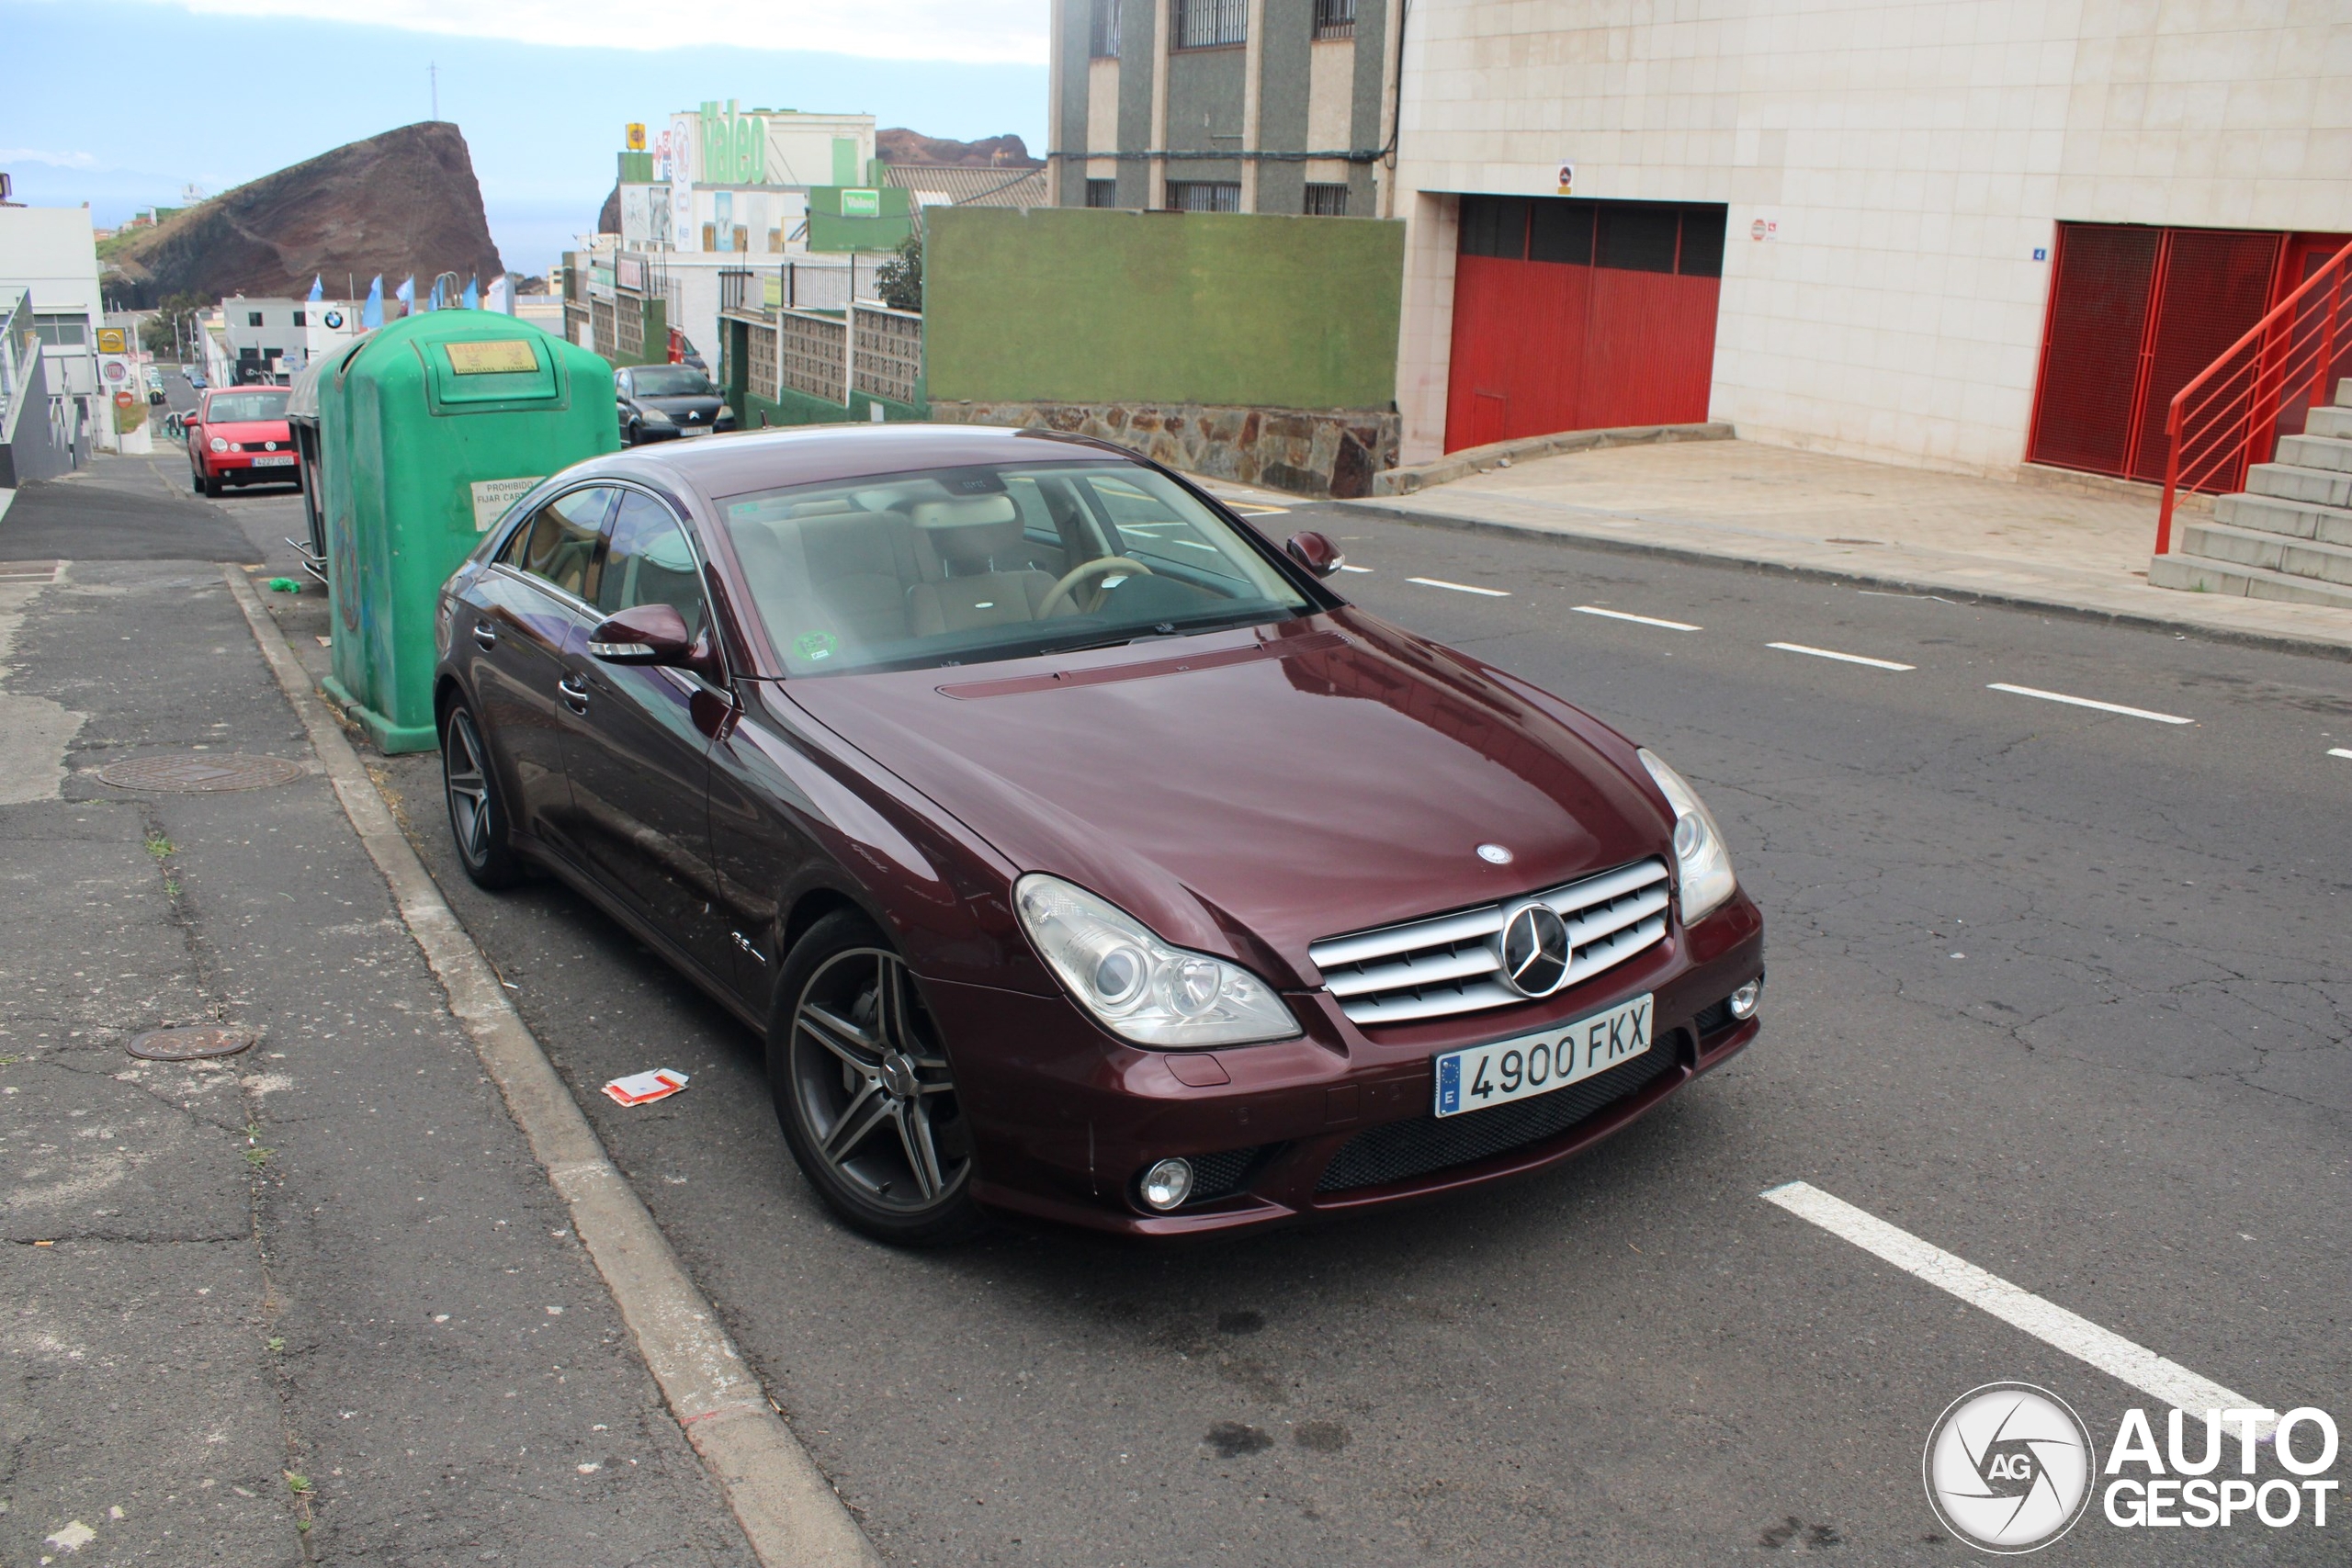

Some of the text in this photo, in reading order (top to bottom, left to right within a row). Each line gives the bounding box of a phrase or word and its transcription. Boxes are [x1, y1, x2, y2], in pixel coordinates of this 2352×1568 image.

[846, 196, 876, 209] Valeo
[487, 480, 533, 492] PROHIBIDO
[478, 493, 500, 503] FIJAR
[1470, 1004, 1646, 1100] 4900 FKX
[1444, 1089, 1454, 1104] E
